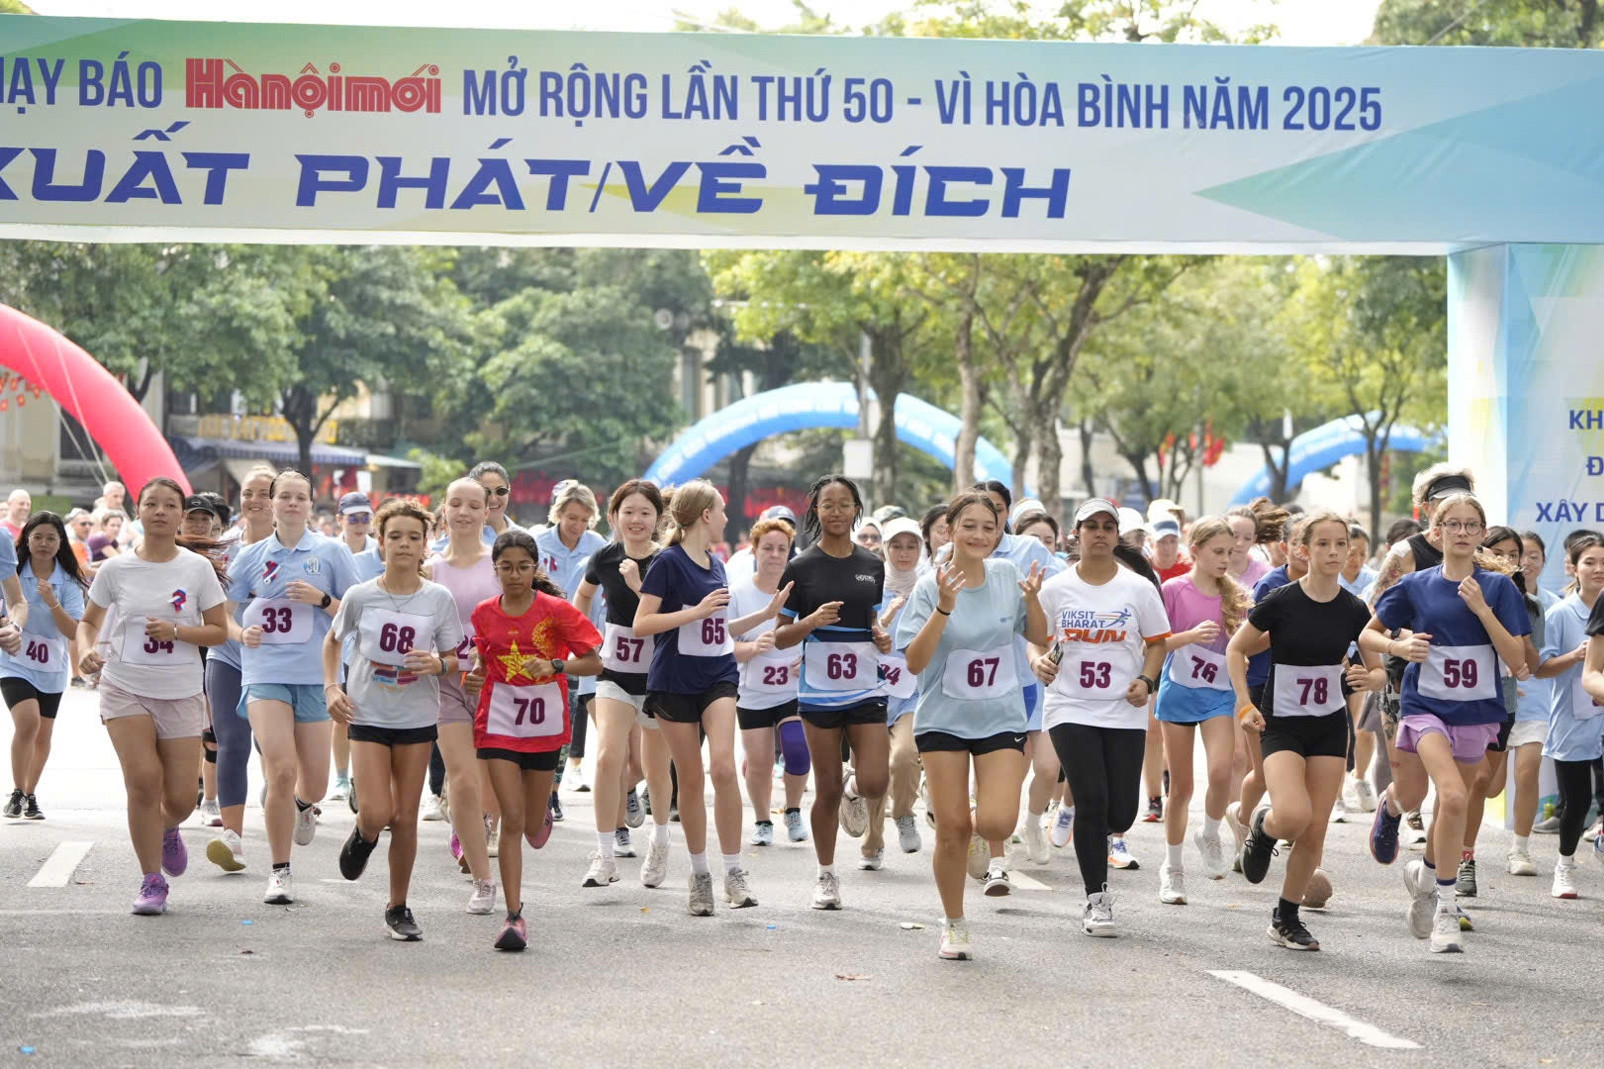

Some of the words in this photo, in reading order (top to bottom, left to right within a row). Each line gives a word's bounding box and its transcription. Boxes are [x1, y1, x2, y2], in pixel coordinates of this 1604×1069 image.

[0, 57, 65, 114] ẠY
[79, 51, 163, 108] BÁO
[463, 56, 527, 116] MỞ
[540, 62, 648, 127] RỘNG
[661, 60, 738, 121] LẦN
[751, 67, 832, 122] THỨ
[843, 78, 893, 123] 50
[935, 71, 971, 125] VÌ
[986, 72, 1064, 127] HÒA
[1077, 74, 1169, 129] BÌNH
[1183, 76, 1269, 130] NĂM
[1283, 86, 1382, 131] 2025
[804, 145, 1071, 219] ĐÍCH
[1569, 409, 1603, 430] KH
[1535, 498, 1588, 523] XÂY
[261, 606, 293, 634] 33
[1061, 610, 1096, 620] VIKSIT
[1061, 619, 1105, 628] BHARAT
[379, 623, 416, 655] 68
[701, 617, 726, 645] 65
[1063, 628, 1127, 644] RUN
[26, 640, 49, 664] 40
[616, 636, 645, 663] 57
[763, 665, 789, 686] 23
[827, 653, 858, 680] 63
[967, 657, 1001, 687] 67
[1079, 661, 1112, 689] 53
[1190, 656, 1219, 684] 76
[1443, 658, 1479, 689] 59
[1296, 677, 1328, 706] 78
[513, 697, 546, 726] 70
